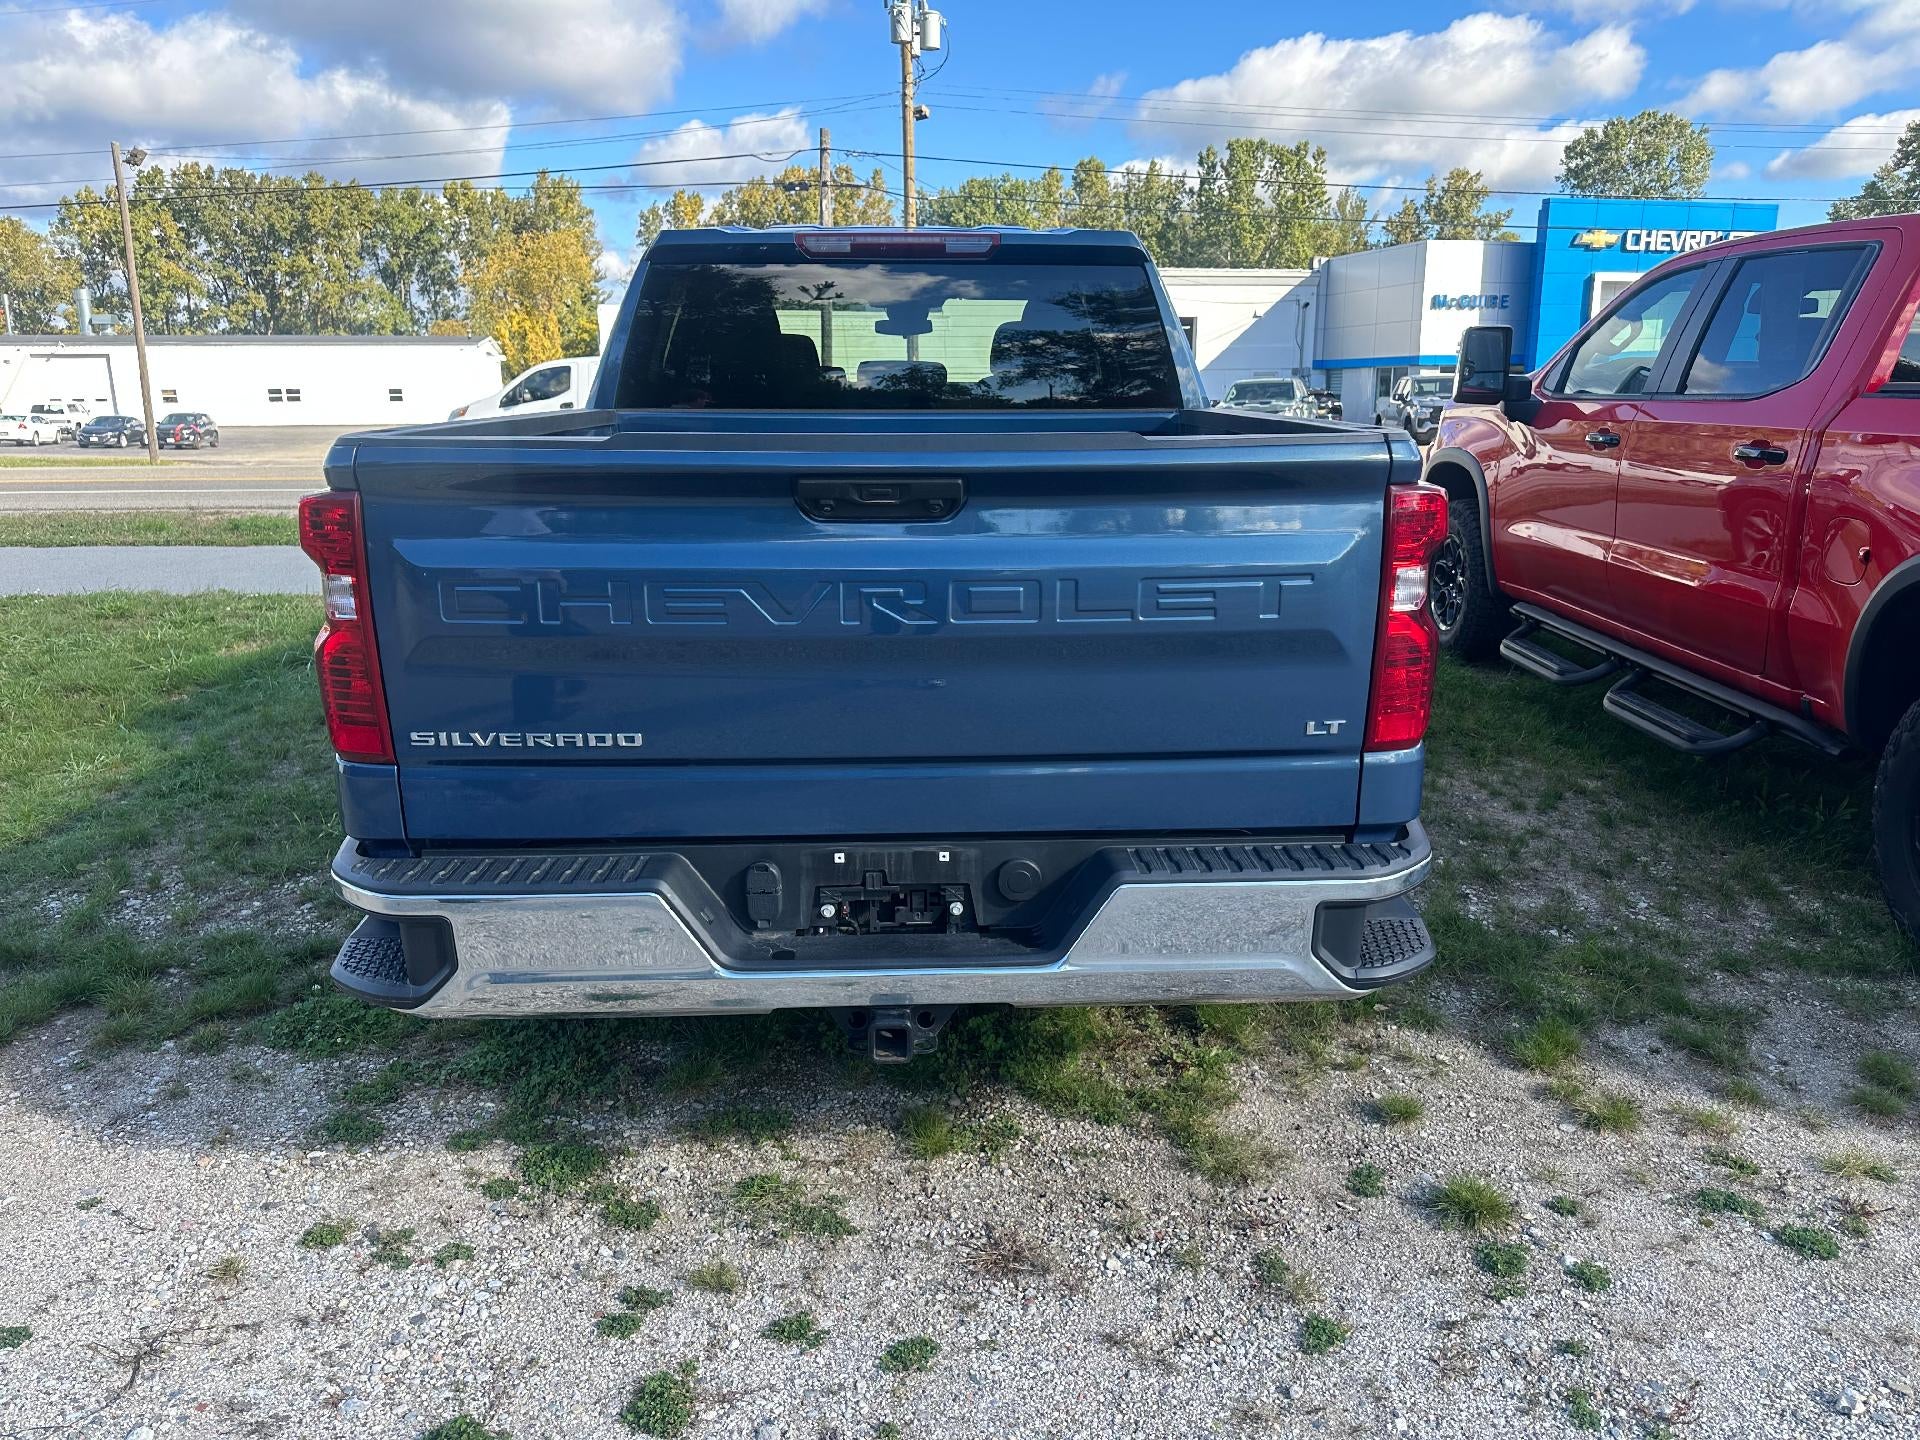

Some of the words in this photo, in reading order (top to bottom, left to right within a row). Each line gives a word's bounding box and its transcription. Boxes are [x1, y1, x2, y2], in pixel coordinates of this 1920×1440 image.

[1627, 229, 1763, 251] CHEVRO
[438, 573, 1315, 626] CHEVROLET
[1306, 719, 1347, 735] LT
[409, 731, 643, 747] SILVERADO
